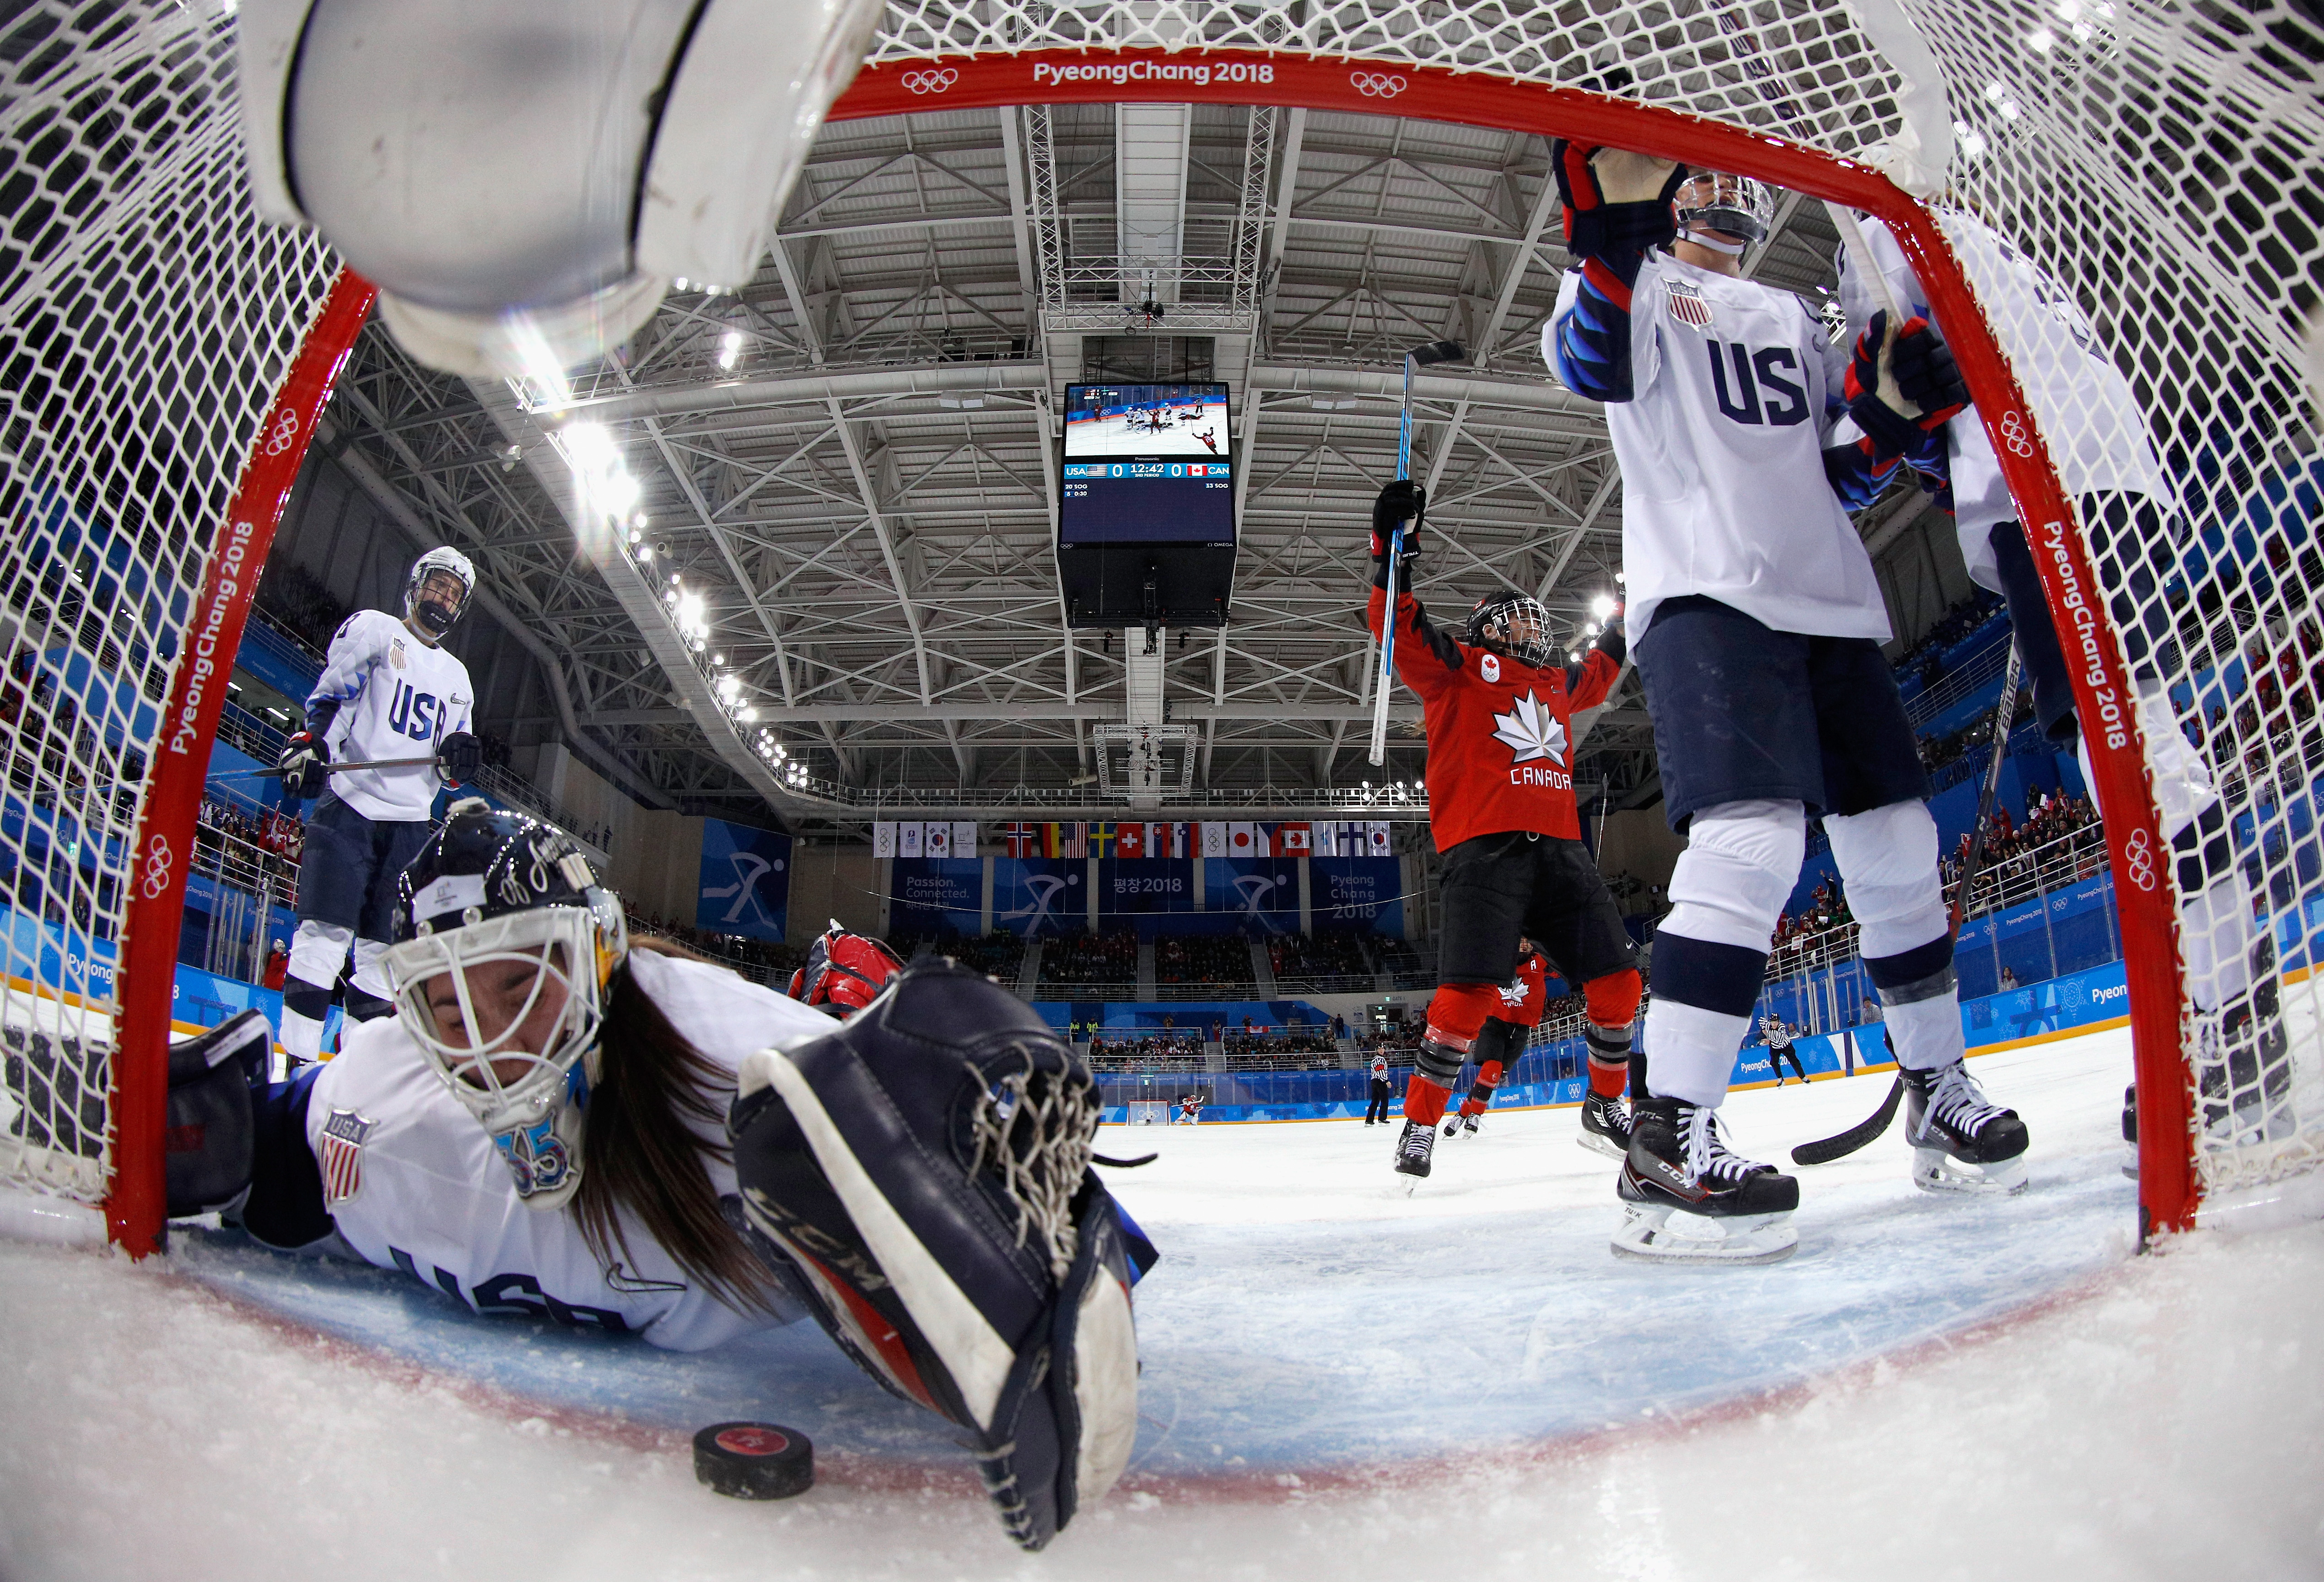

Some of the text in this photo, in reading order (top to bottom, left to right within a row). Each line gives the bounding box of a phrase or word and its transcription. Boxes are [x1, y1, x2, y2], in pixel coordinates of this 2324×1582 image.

[1034, 61, 1274, 86] PyeongChang 2018
[1707, 339, 1811, 425] US
[1066, 468, 1086, 476] USA
[1112, 464, 1123, 477] 0
[1130, 464, 1165, 473] 12:42
[1171, 464, 1182, 477] 0
[1208, 467, 1229, 475] CAN
[171, 521, 253, 755] PyeongChang 2018
[2044, 520, 2126, 751] PyeongChang 2018
[388, 678, 447, 753] USA
[1510, 767, 1571, 790] CANADA
[907, 876, 956, 887] Passion.
[1114, 877, 1182, 893] 평창 2018
[1331, 875, 1375, 887] Pyeong
[906, 888, 970, 899] Connected.
[1331, 888, 1375, 900] Chang
[2077, 886, 2107, 900] PyeongChag
[1332, 903, 1377, 919] 2018
[2006, 908, 2042, 926] PyeongChang 2018
[1530, 959, 1537, 970] A
[2092, 984, 2127, 1005] Pyeon
[1779, 1056, 1790, 1066] 20
[330, 1116, 360, 1140] USA
[1930, 1125, 1949, 1141] CM
[1624, 1206, 1643, 1218] TUK
